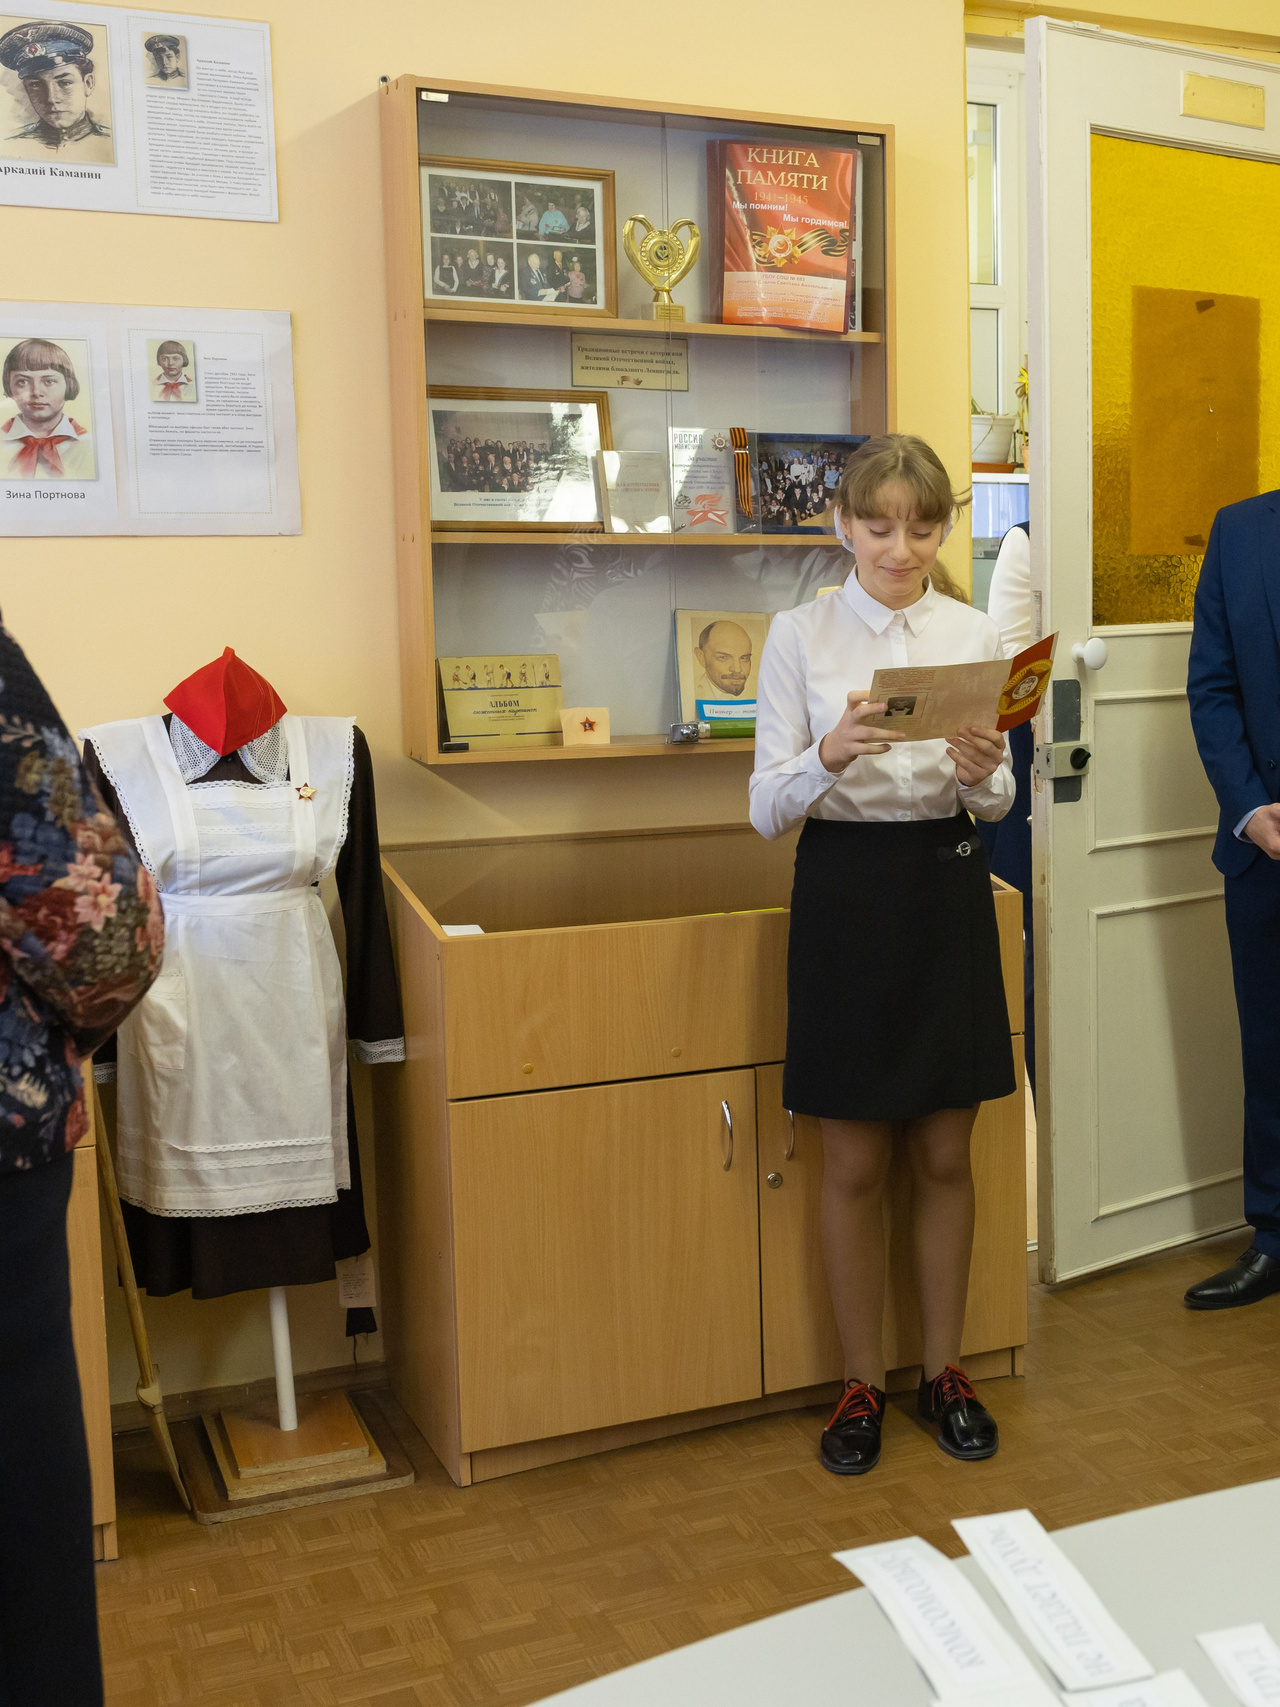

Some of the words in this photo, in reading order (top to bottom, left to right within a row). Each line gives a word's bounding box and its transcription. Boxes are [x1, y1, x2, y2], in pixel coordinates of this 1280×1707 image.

[747, 147, 820, 168] КНИГА
[50, 167, 102, 180] Каманин
[736, 169, 829, 191] ПАМЯТИ
[732, 201, 747, 210] Мы
[750, 202, 788, 212] помним!
[783, 214, 799, 223] Мы
[801, 216, 848, 229] гордимся!
[577, 346, 621, 354] Традиционные
[611, 356, 654, 364] Отечественной
[674, 433, 704, 444] РОССИЯ
[6, 490, 32, 499] Зина
[34, 490, 87, 501] Портнова
[489, 699, 520, 708] АЛЬБОМ
[508, 708, 538, 716] картинок
